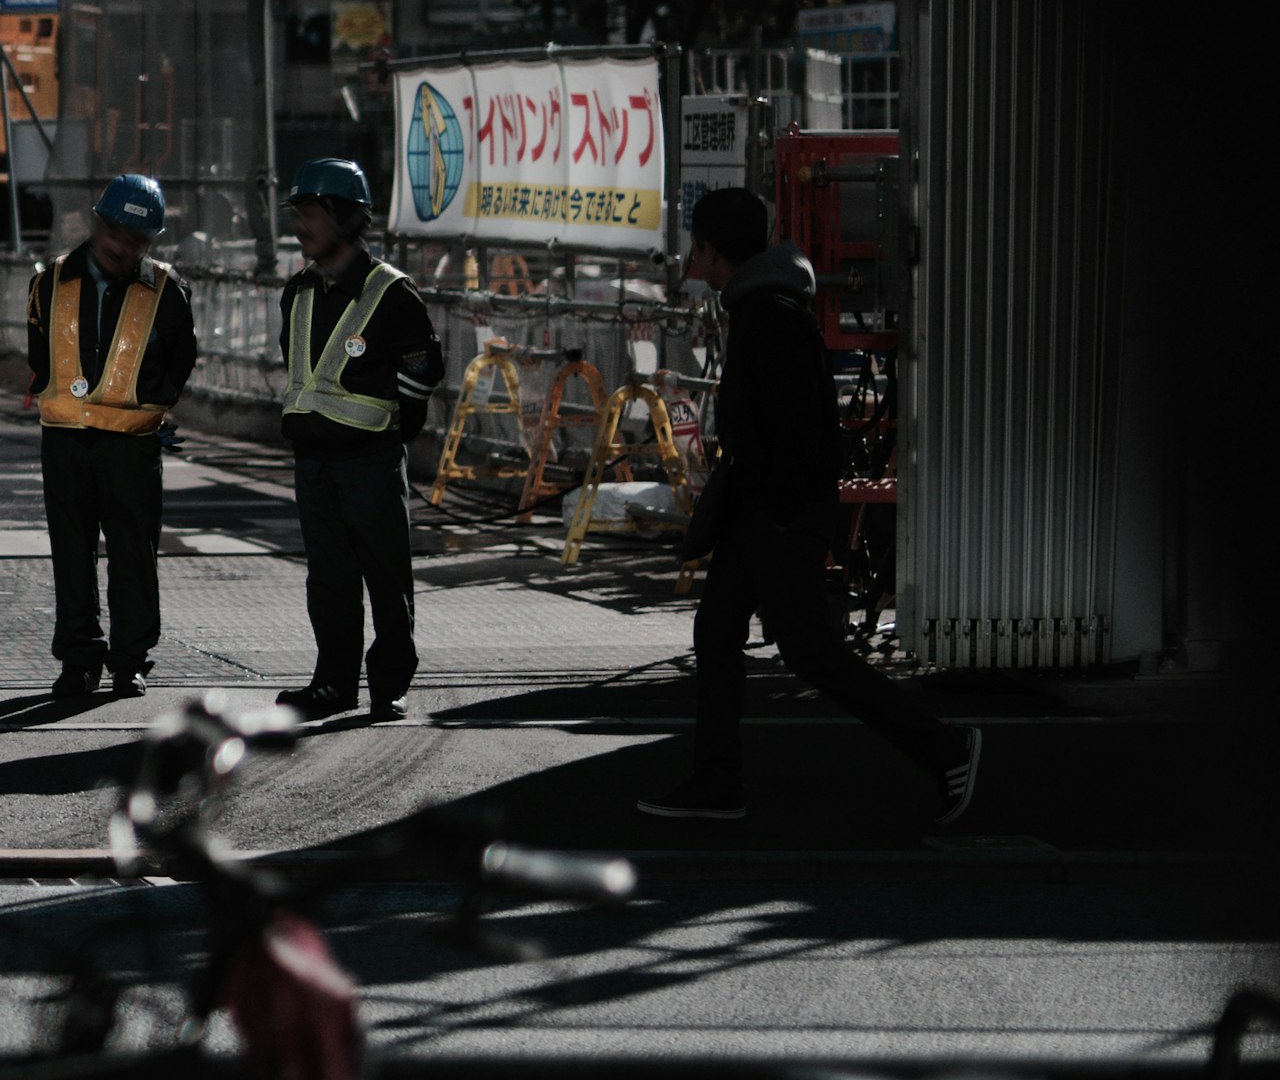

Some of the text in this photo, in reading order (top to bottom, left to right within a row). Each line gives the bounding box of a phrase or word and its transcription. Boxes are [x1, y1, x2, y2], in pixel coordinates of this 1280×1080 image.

[480, 185, 641, 224] 明るい未来に向けて今できること
